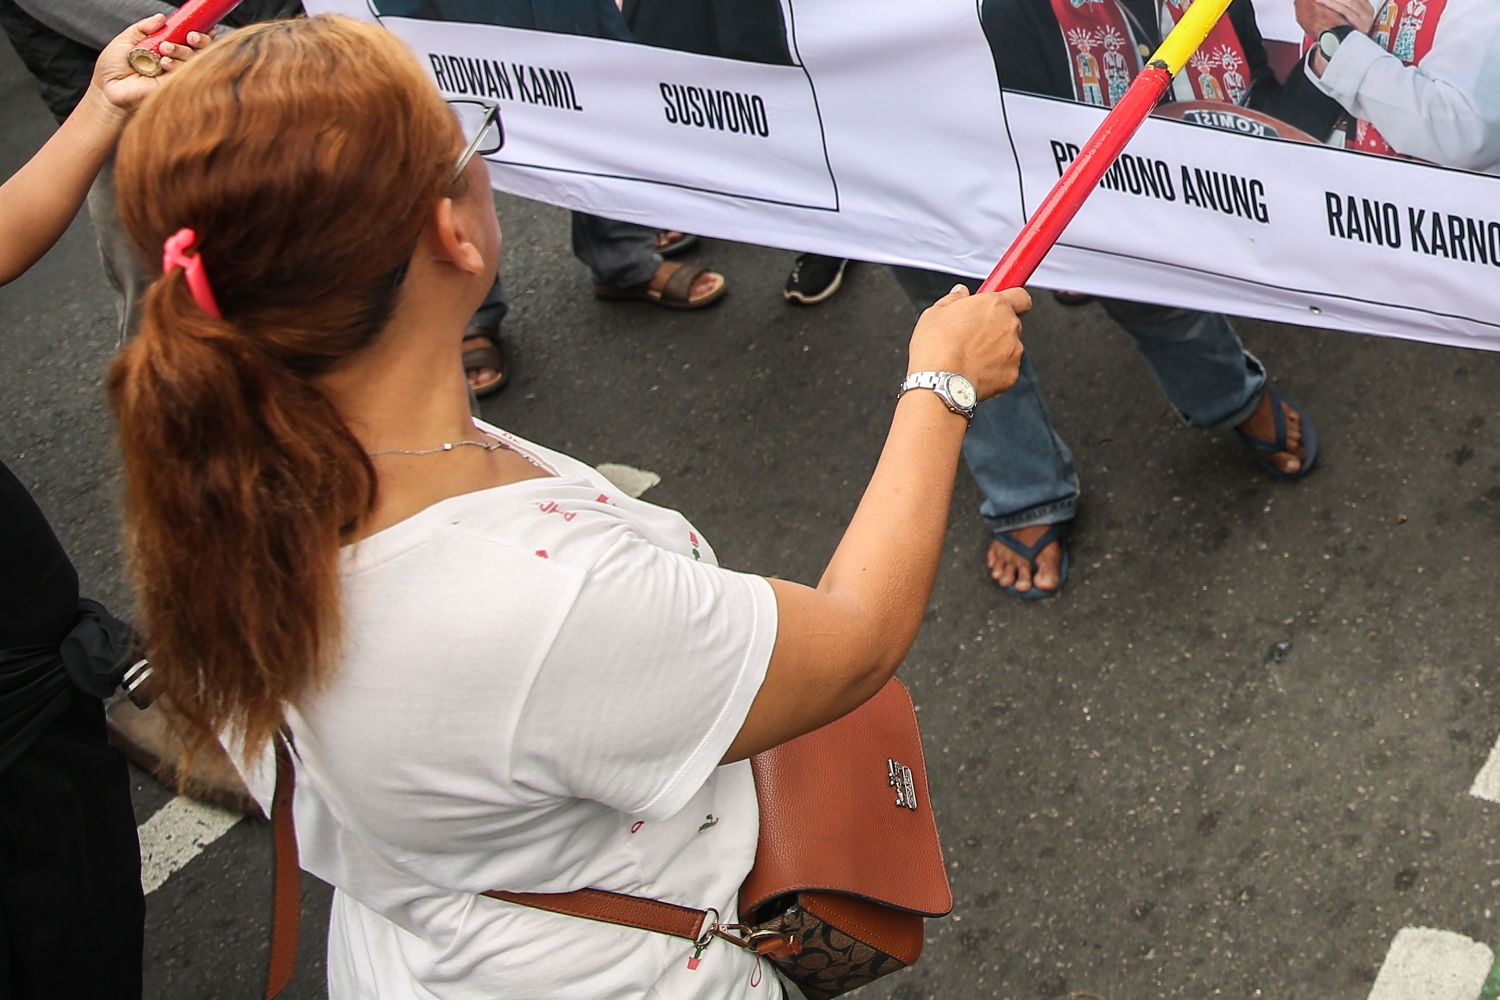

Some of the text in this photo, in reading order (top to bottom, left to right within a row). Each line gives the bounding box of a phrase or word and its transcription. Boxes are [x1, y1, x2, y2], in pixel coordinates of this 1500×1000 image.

[429, 53, 583, 111] RIDWAN KAMIL
[659, 82, 769, 138] SUSWONO
[1050, 140, 1269, 224] PMONO ANUNG
[1325, 191, 1401, 249] RANO
